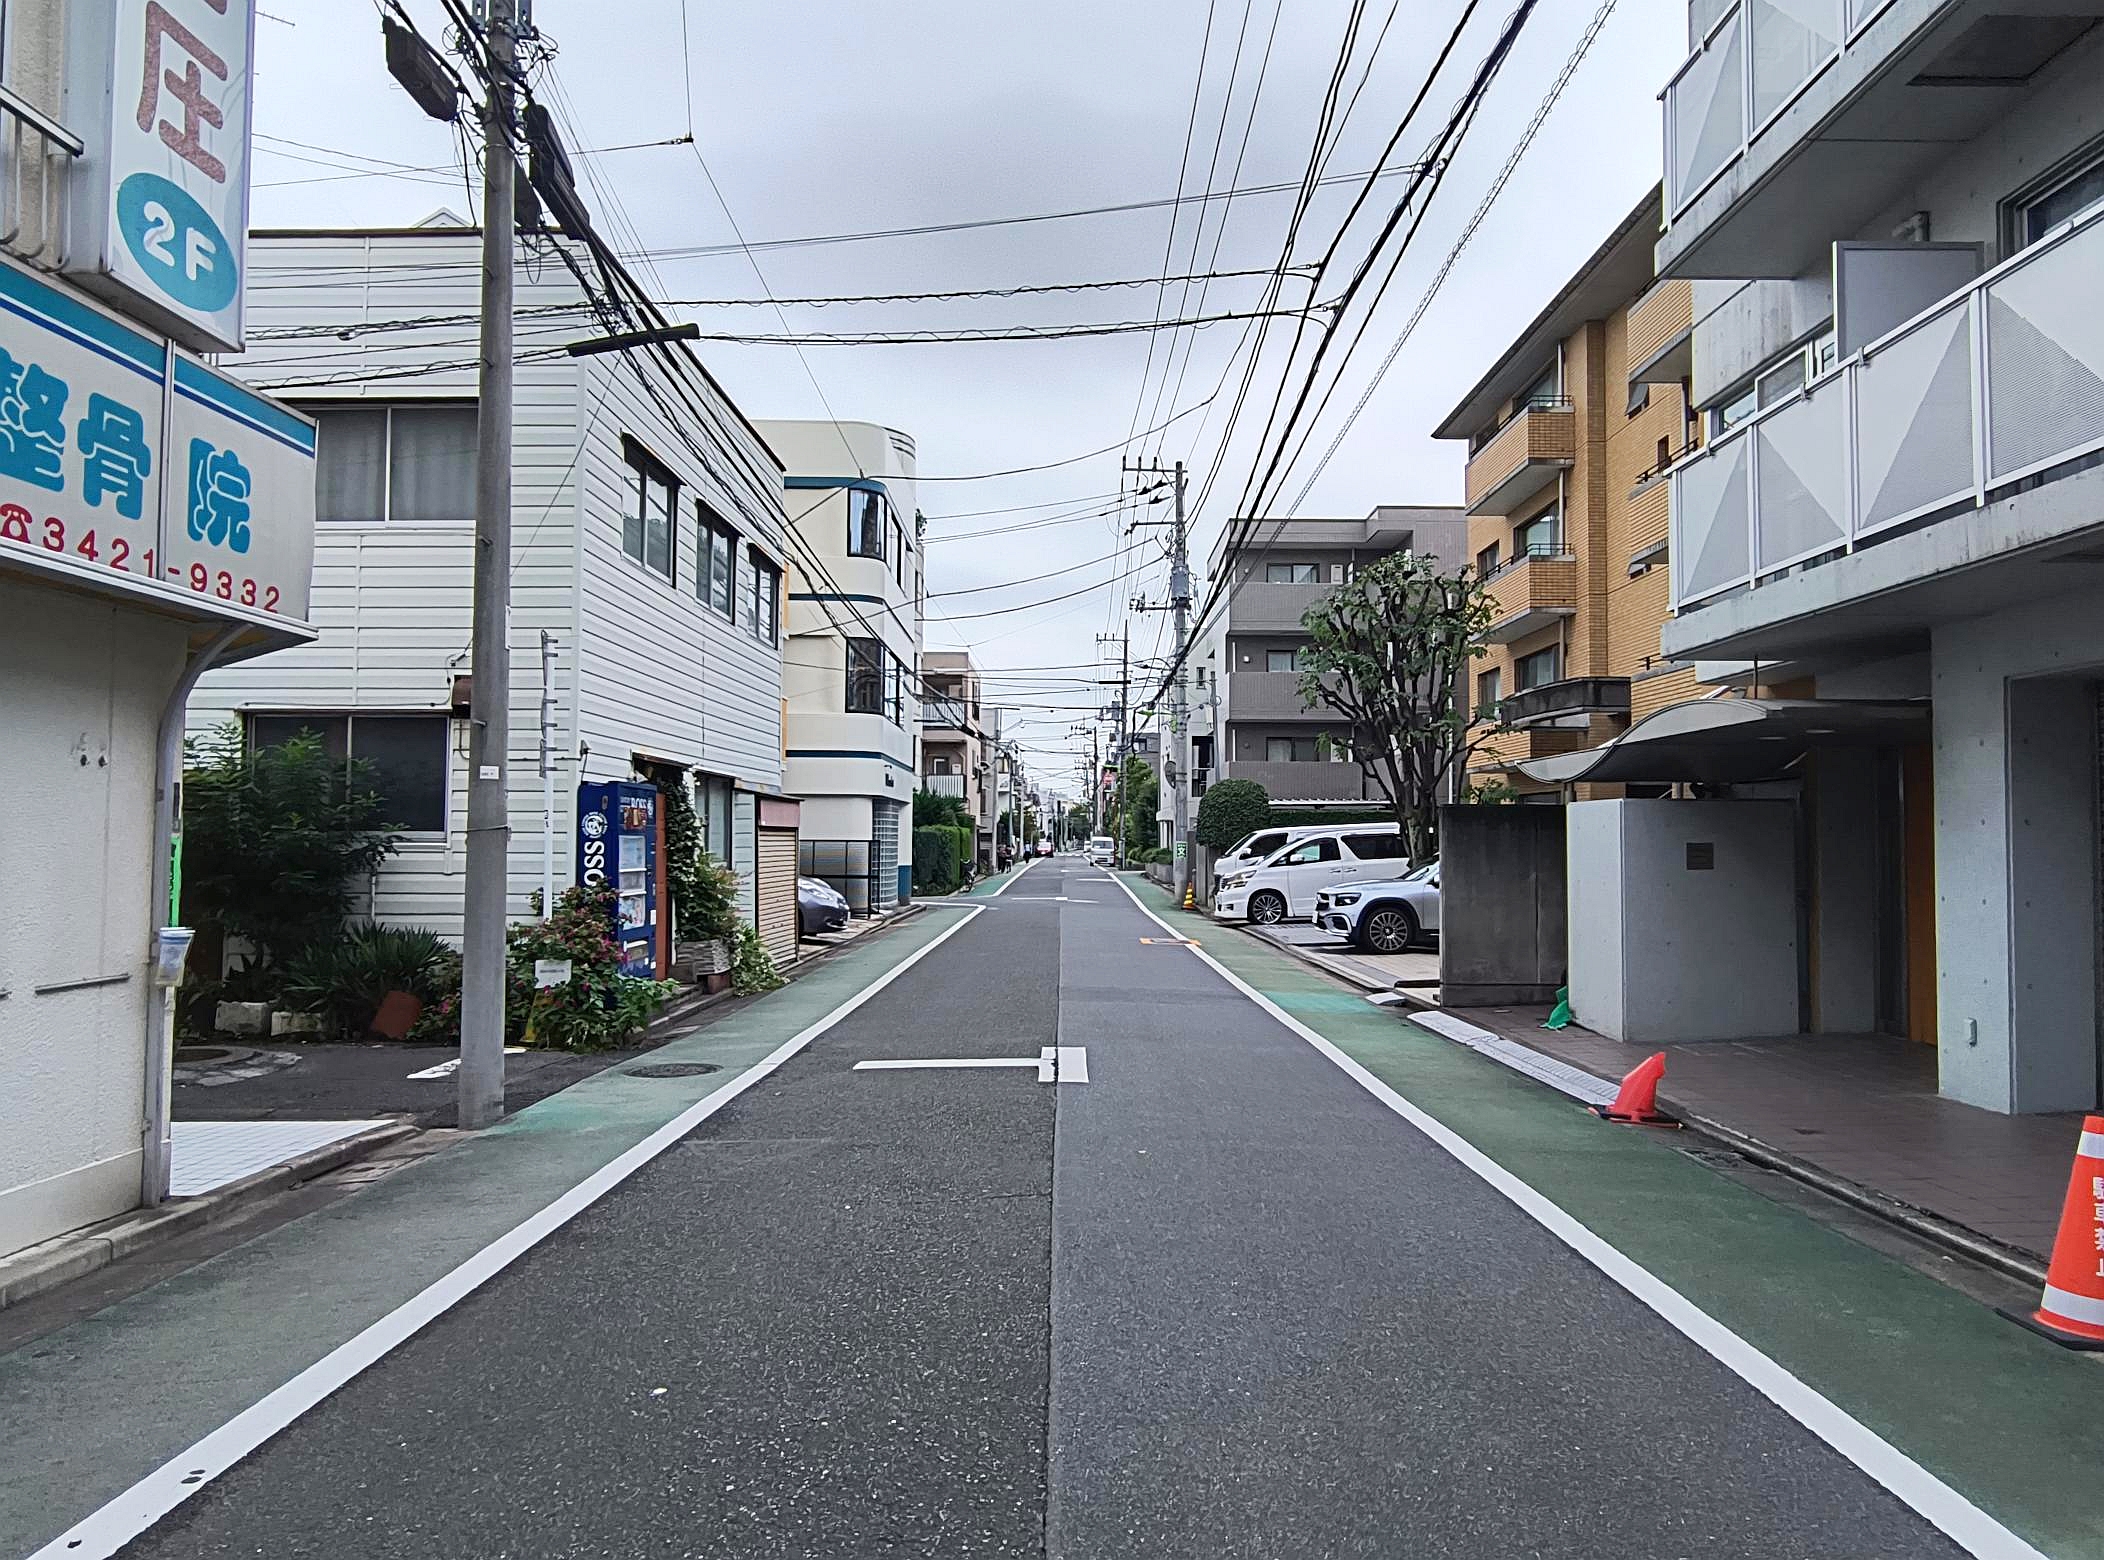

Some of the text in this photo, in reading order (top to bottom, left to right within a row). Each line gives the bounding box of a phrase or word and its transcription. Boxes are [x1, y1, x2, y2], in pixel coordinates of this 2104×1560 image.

[137, 0, 228, 183] 圧
[143, 200, 217, 281] 2F
[42, 517, 280, 614] 3421-9332
[584, 840, 605, 887] OSS
